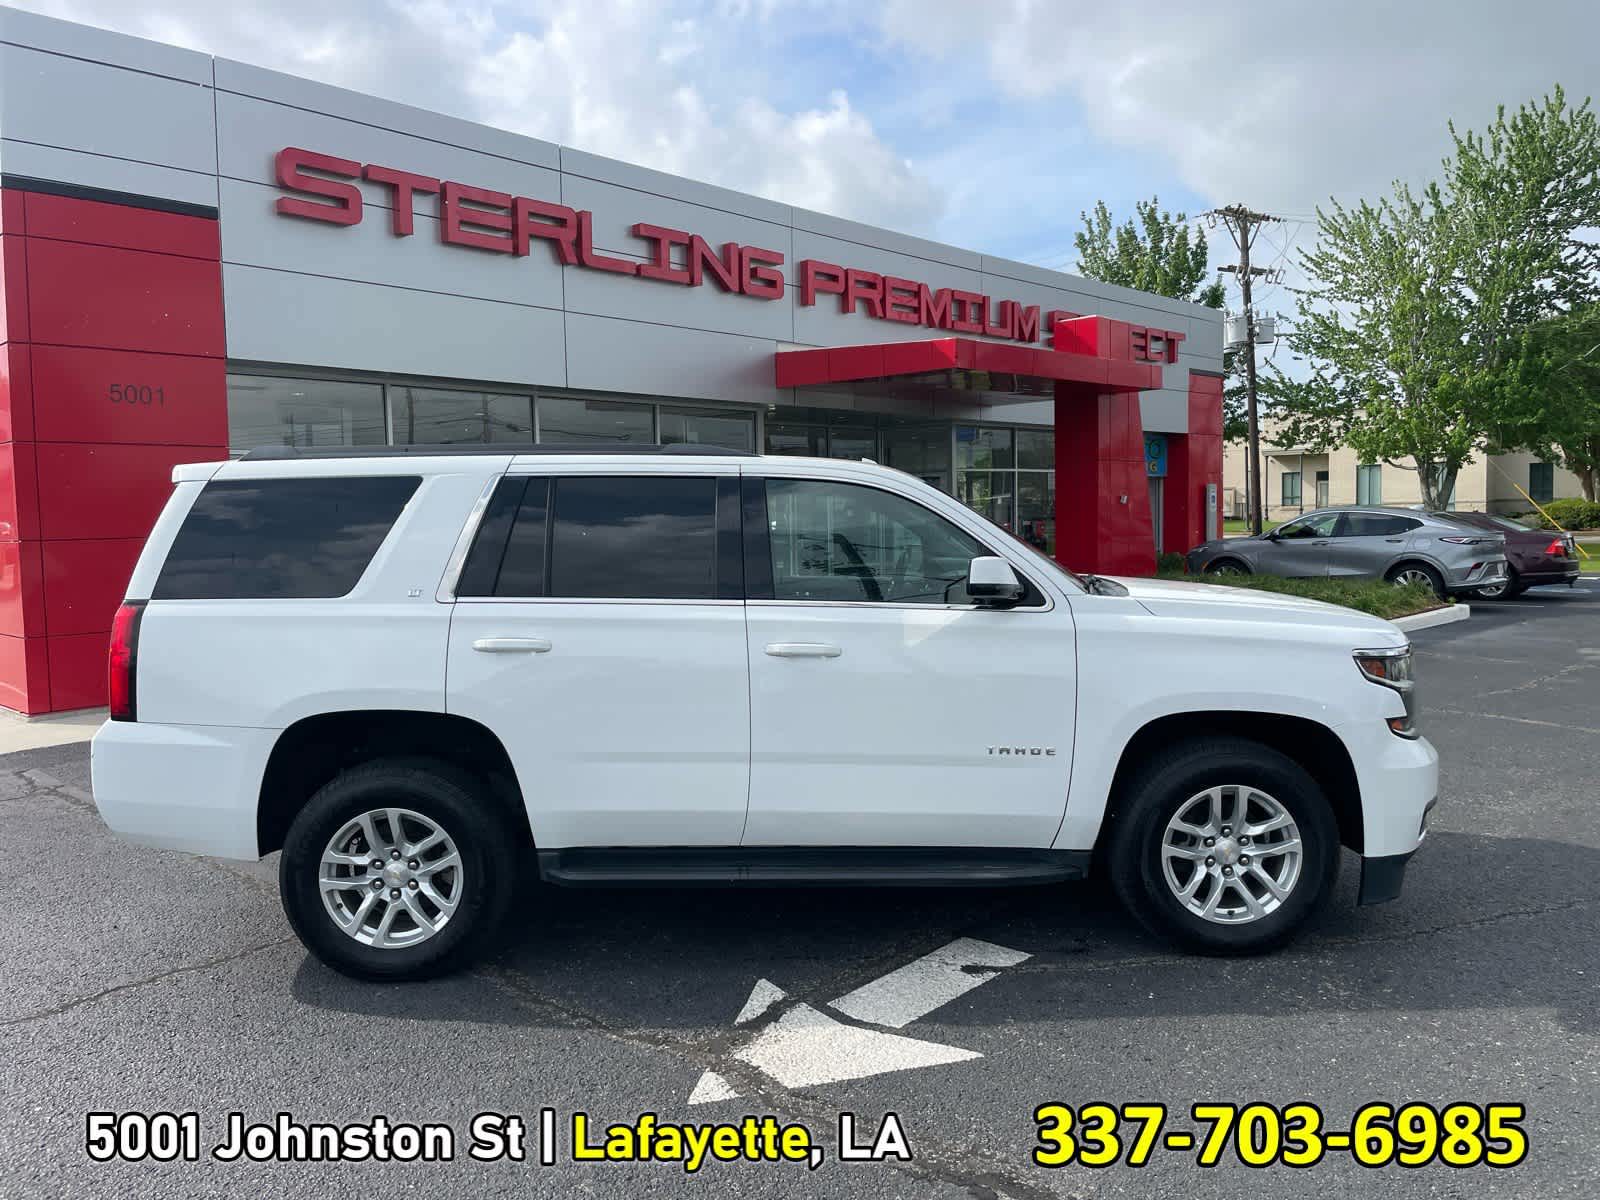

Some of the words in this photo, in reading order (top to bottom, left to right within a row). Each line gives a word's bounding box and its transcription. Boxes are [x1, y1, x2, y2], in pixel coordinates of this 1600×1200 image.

[275, 147, 785, 300] STERLING
[799, 259, 1040, 343] PREMIUM
[1047, 310, 1186, 364] ECT
[110, 384, 164, 408] 5001
[986, 745, 1057, 756] TAHOE
